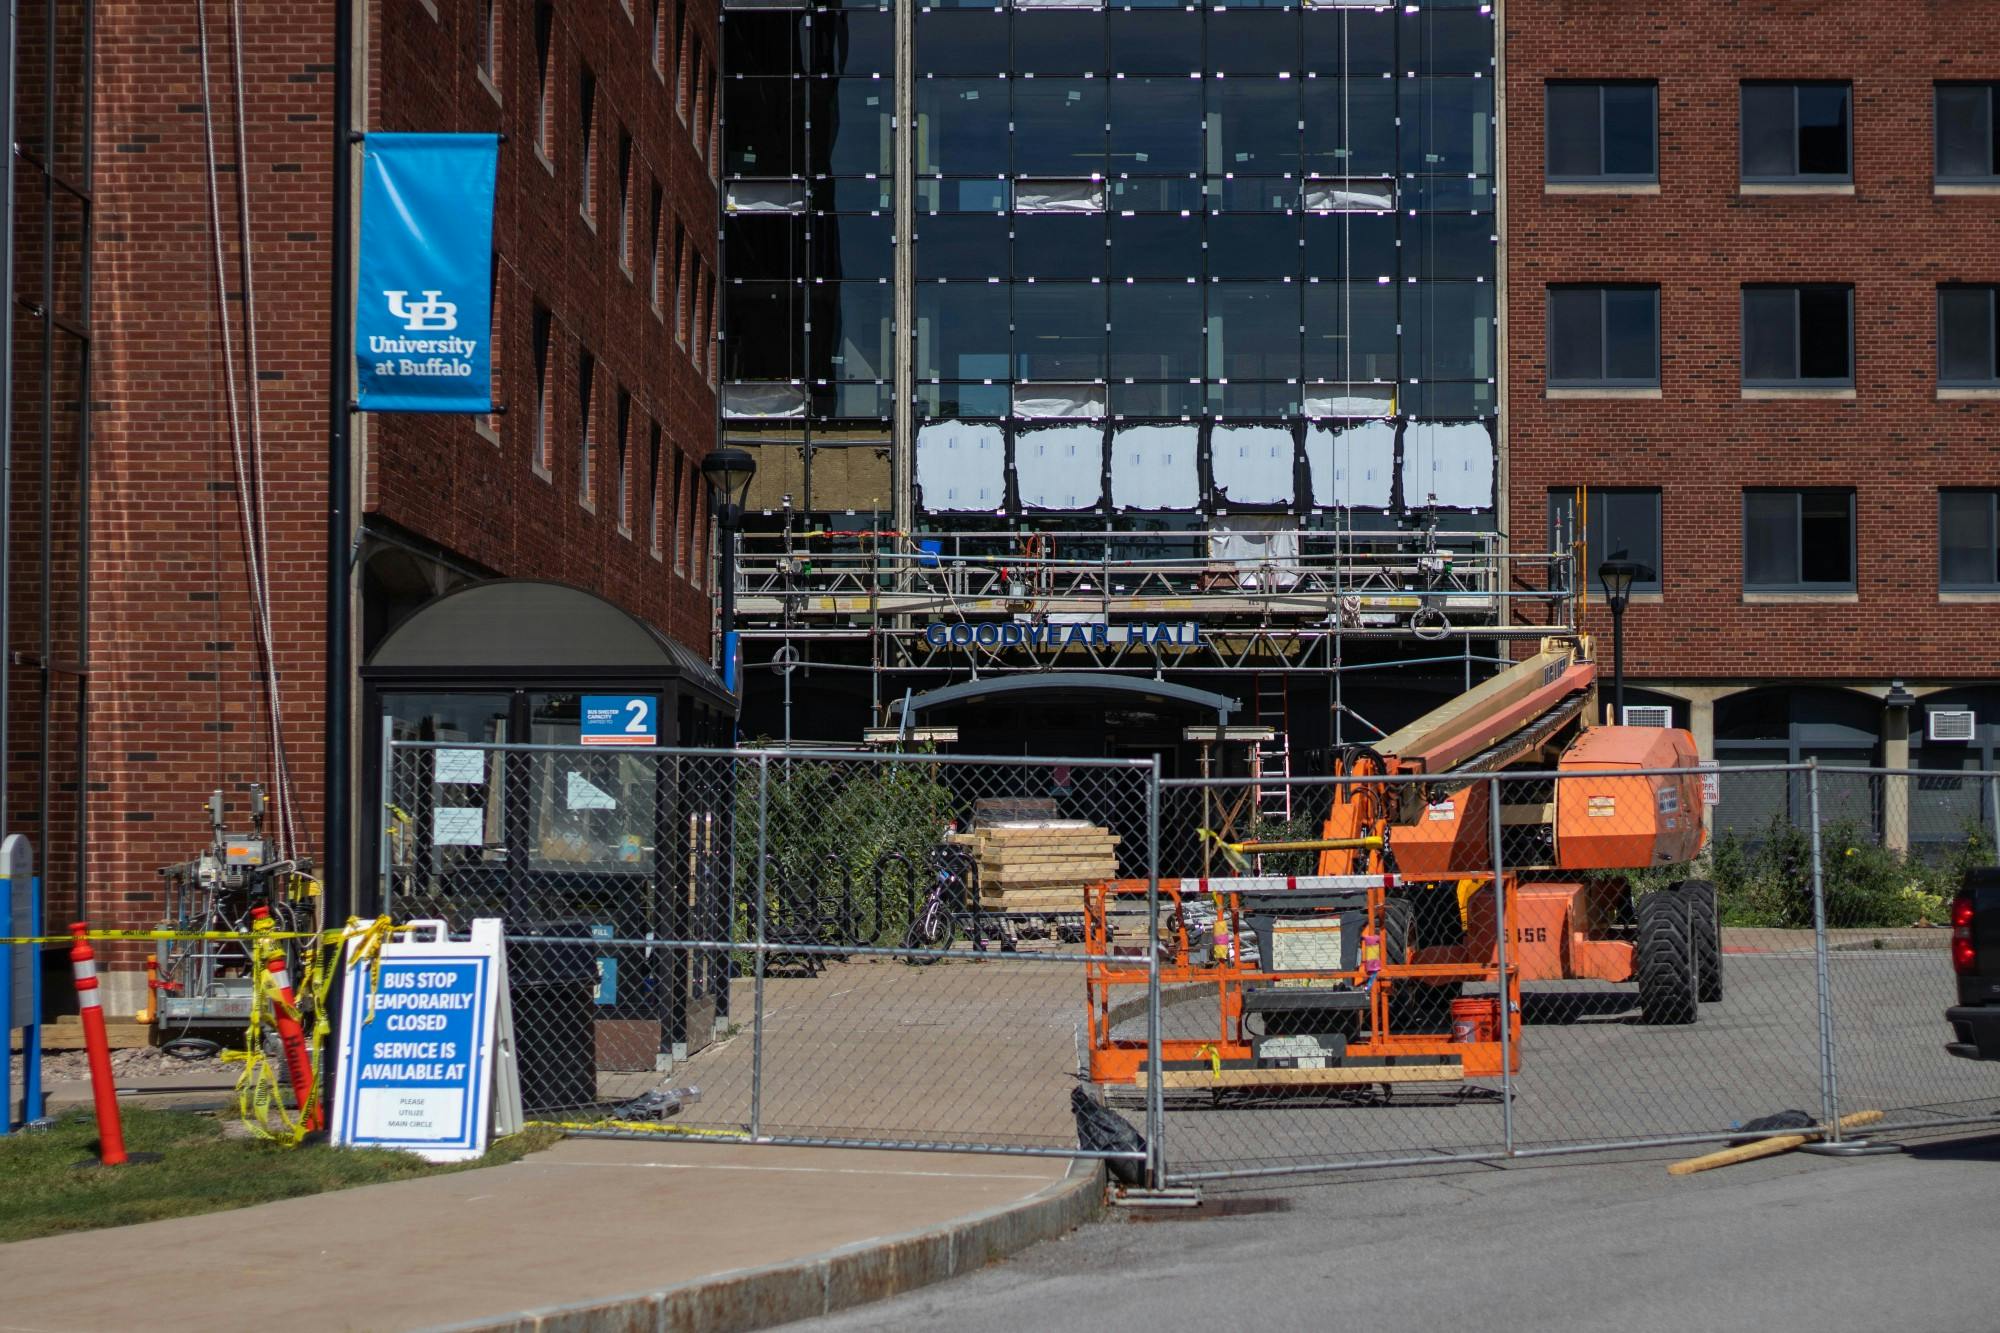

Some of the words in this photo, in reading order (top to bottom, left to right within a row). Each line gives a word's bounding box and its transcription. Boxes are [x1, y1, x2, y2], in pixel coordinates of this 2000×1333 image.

[383, 290, 457, 330] UB
[369, 335, 477, 359] University
[375, 359, 396, 376] at
[399, 358, 472, 376] Buffalo
[926, 621, 1110, 647] GOODYEAR
[1126, 621, 1209, 647] HALL
[625, 699, 648, 732] 2
[384, 972, 415, 989] BUS
[417, 972, 458, 989] STOP
[365, 993, 474, 1010] TEMPORARILY
[386, 1014, 448, 1031] CLOSED
[373, 1042, 439, 1059] SERVICE
[440, 1042, 457, 1059] IS
[360, 1063, 444, 1080] AVAILABLE
[444, 1063, 466, 1080] AT
[399, 1098, 425, 1106] PLEASE
[398, 1109, 424, 1117] UTILIZE
[387, 1120, 408, 1128] MAIN
[409, 1120, 433, 1128] CIRCLE
